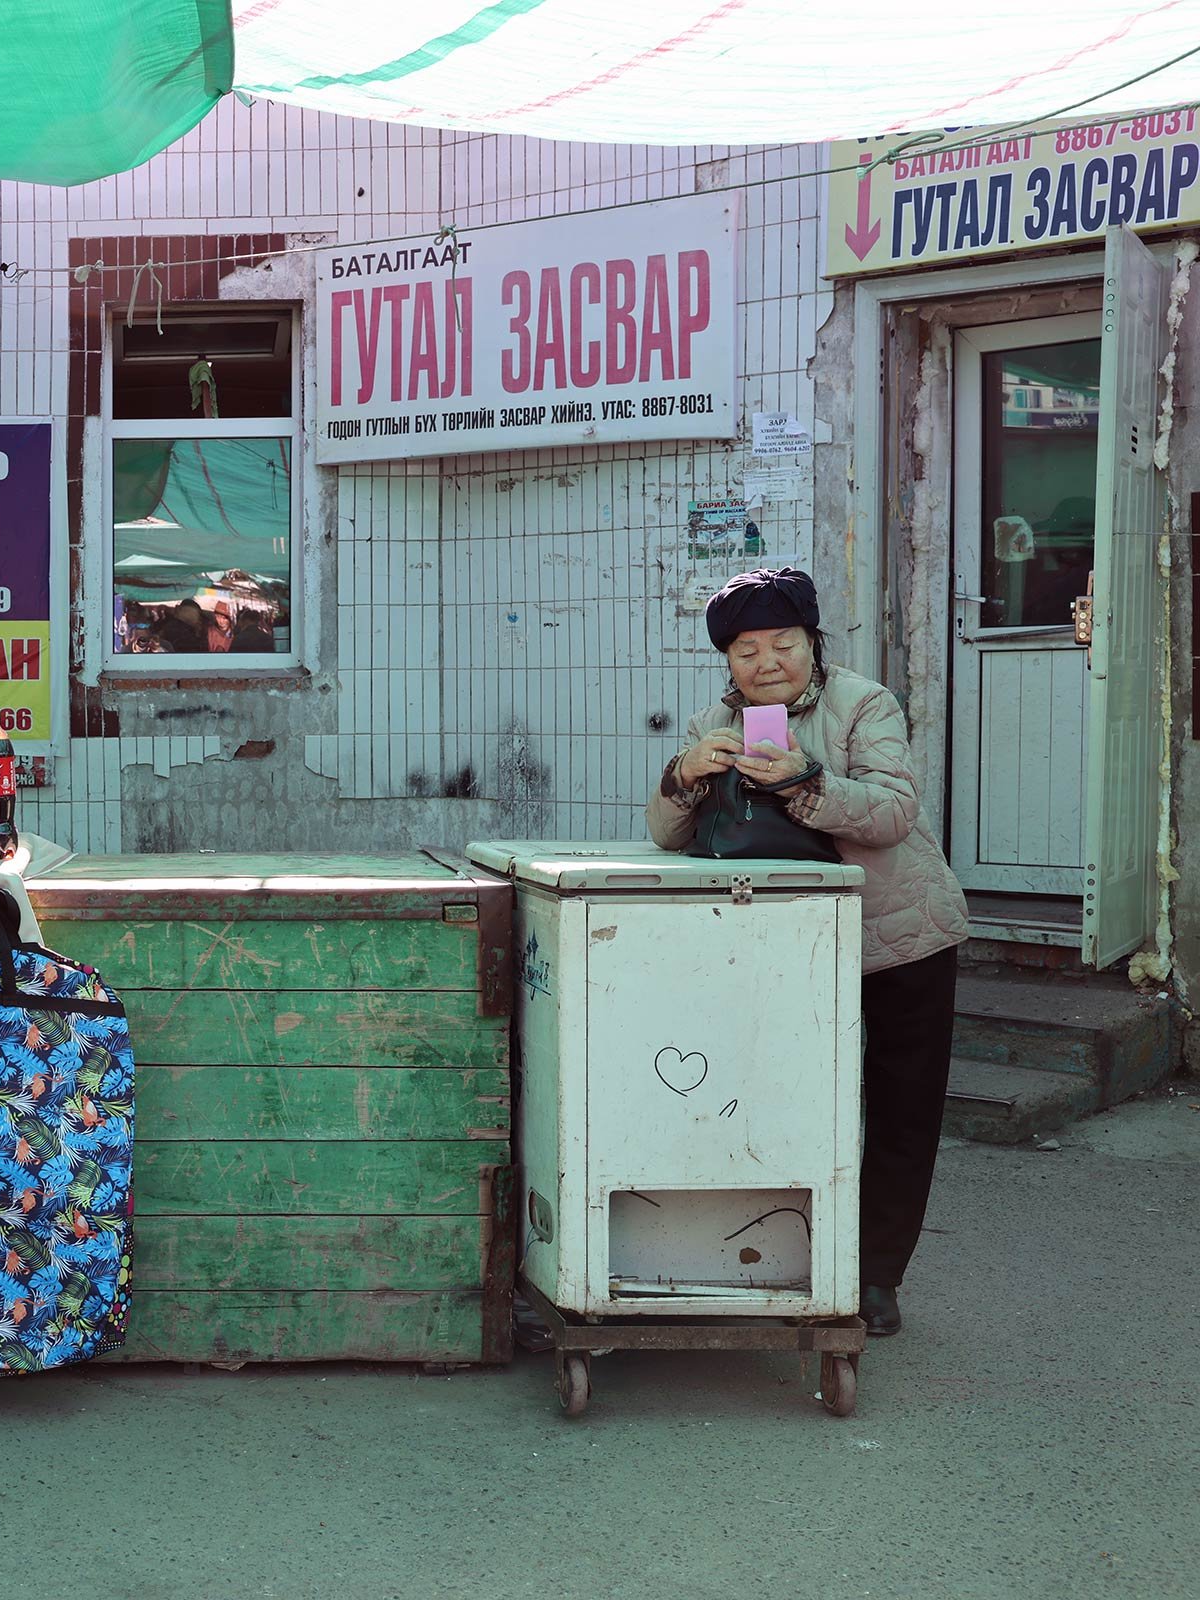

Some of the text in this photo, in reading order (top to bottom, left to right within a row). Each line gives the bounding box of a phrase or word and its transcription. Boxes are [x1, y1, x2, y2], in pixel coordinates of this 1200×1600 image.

[891, 143, 1200, 258] ГУТАЛ ЗАСВАР
[331, 242, 472, 279] БАТАЛГААТ
[330, 249, 711, 407] ГУТАЛ ЗАСВАР
[327, 393, 714, 440] ГОДОН ГУТЛЫН БҮХ ТӨРЛИЙН ЗАСВАР ХИЙНЭ. УТАС: 8867-8031
